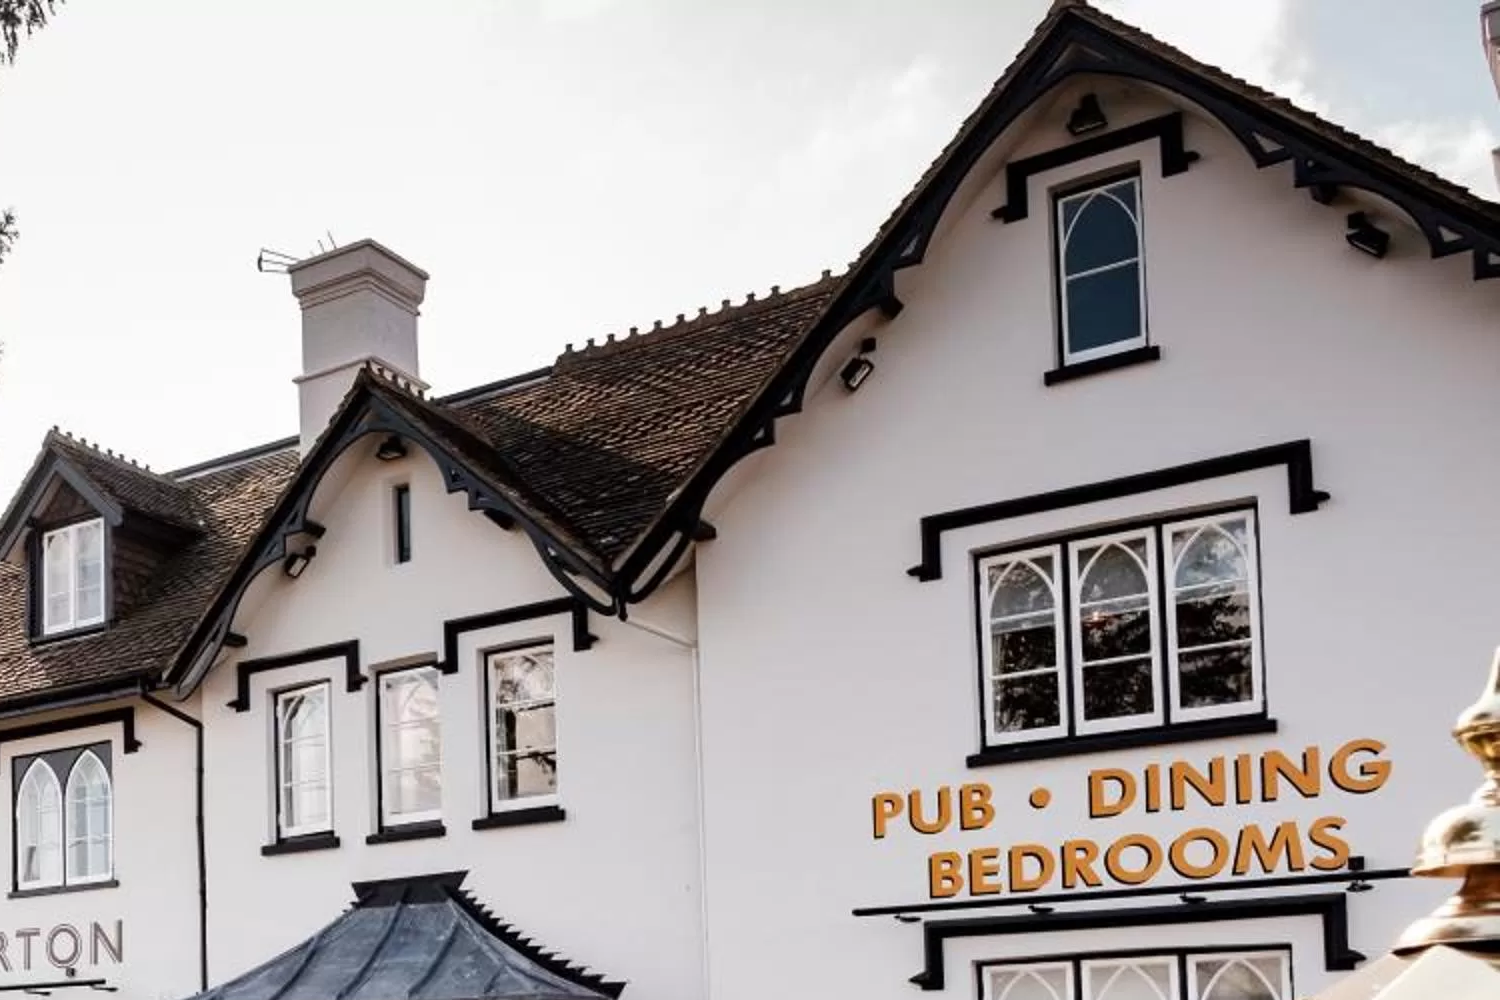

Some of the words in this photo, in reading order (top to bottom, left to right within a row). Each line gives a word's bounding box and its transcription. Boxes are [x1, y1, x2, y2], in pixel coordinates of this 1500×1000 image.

[872, 783, 996, 838] PUB
[1088, 738, 1393, 818] DINING
[928, 816, 1352, 898] BEDROOMS
